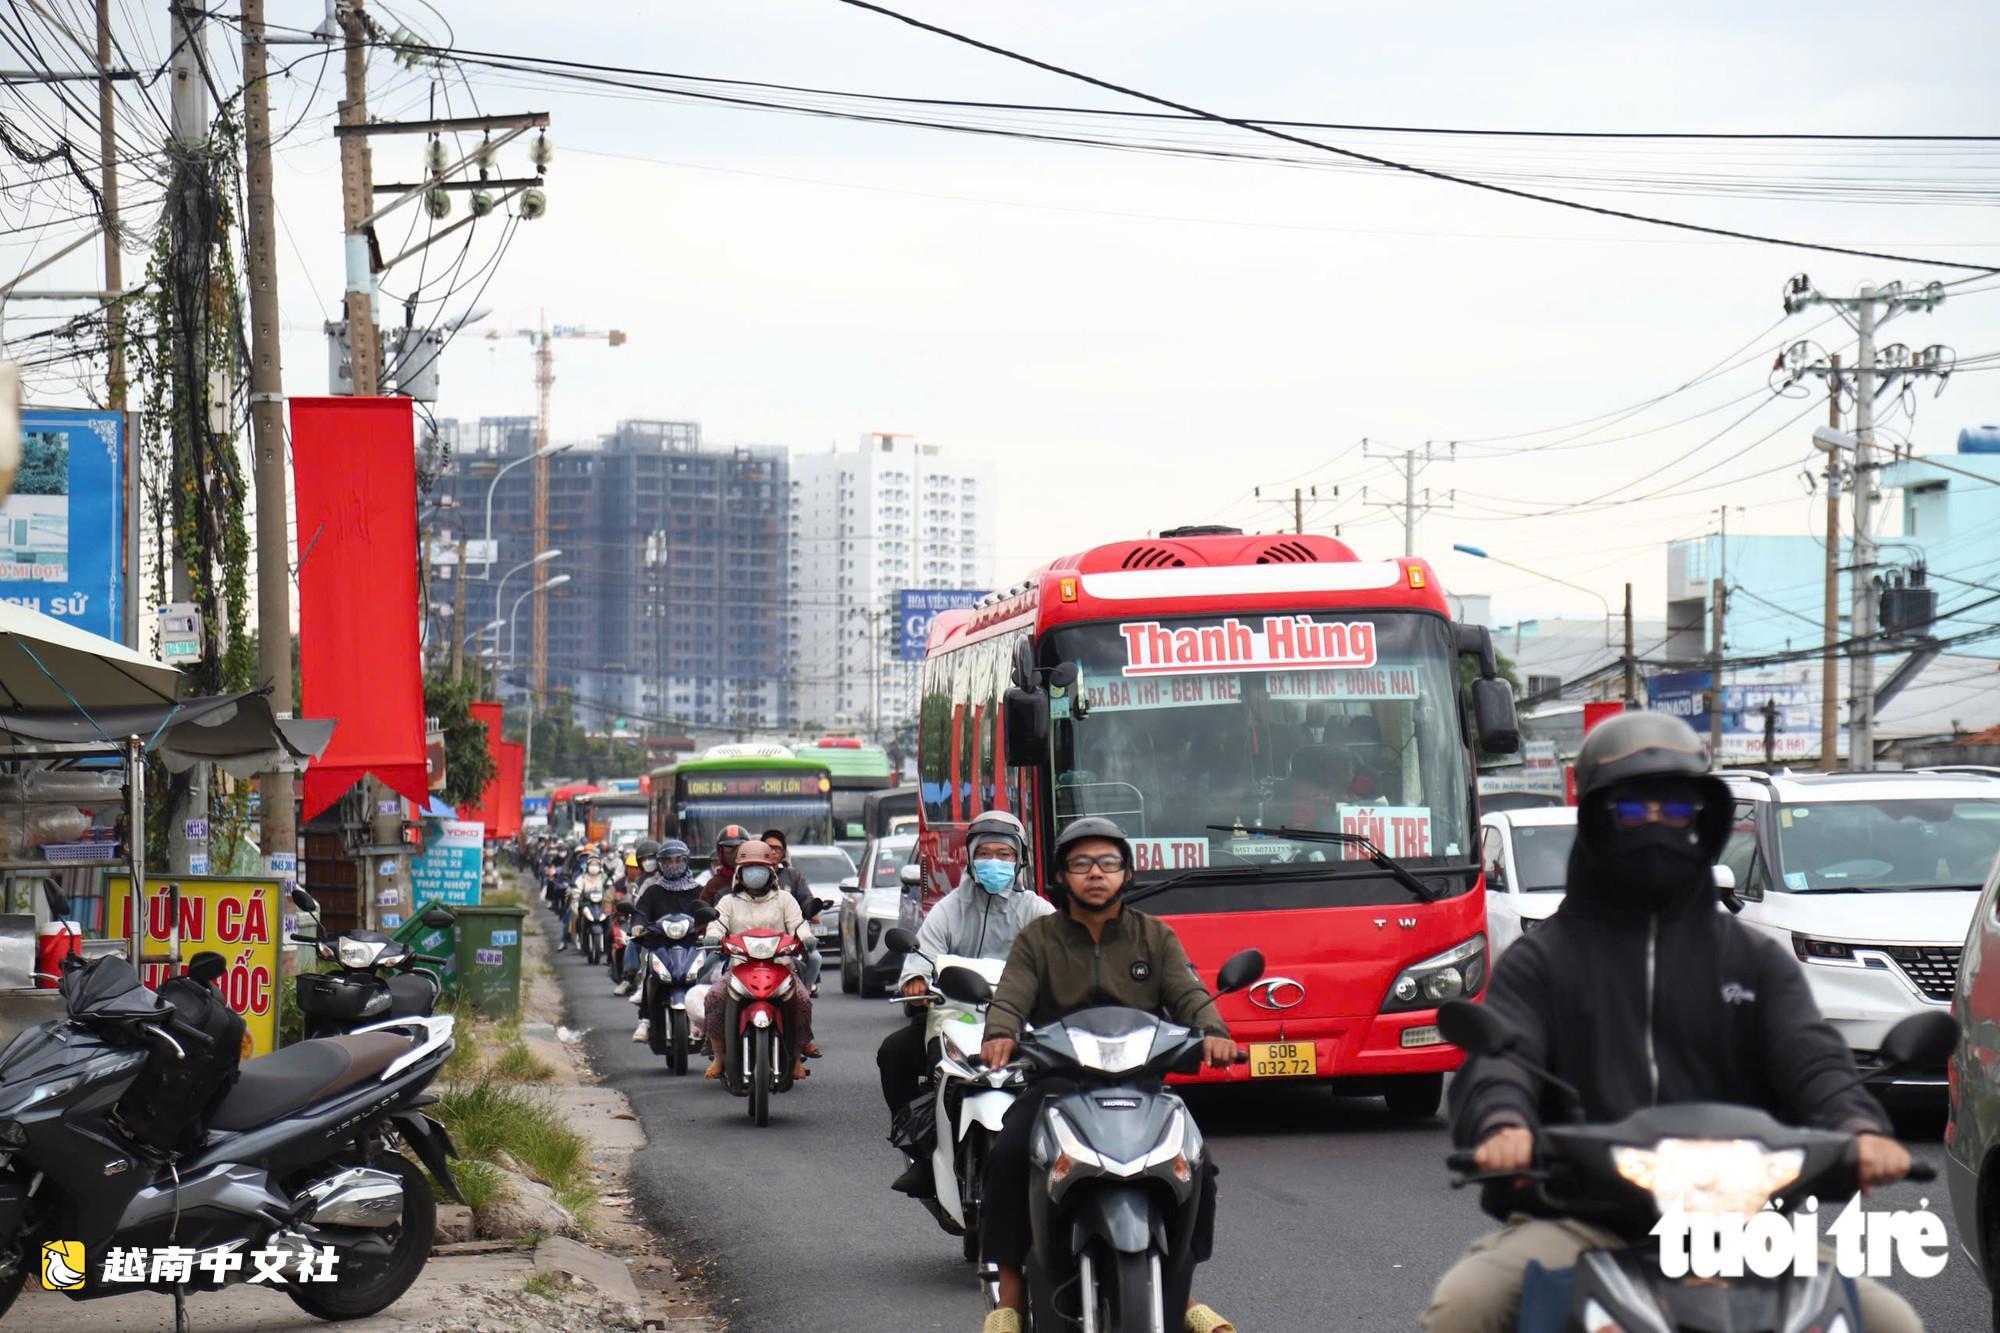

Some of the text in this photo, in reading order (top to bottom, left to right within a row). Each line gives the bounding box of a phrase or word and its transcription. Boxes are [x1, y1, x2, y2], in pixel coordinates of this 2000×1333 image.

[50, 591, 89, 616] SỬ
[1122, 617, 1376, 666] Thanh Hùng
[1135, 681, 1160, 705] TRI
[1208, 675, 1236, 700] TRE
[1390, 670, 1415, 695] NAI
[447, 829, 479, 837] YOKO
[1391, 816, 1432, 859] TRE
[1136, 843, 1205, 871] BA TRI
[217, 889, 268, 943] CÁ
[1269, 1044, 1297, 1059] 60B
[1258, 1060, 1310, 1076] 032.72
[1102, 1100, 1137, 1108] HONDA
